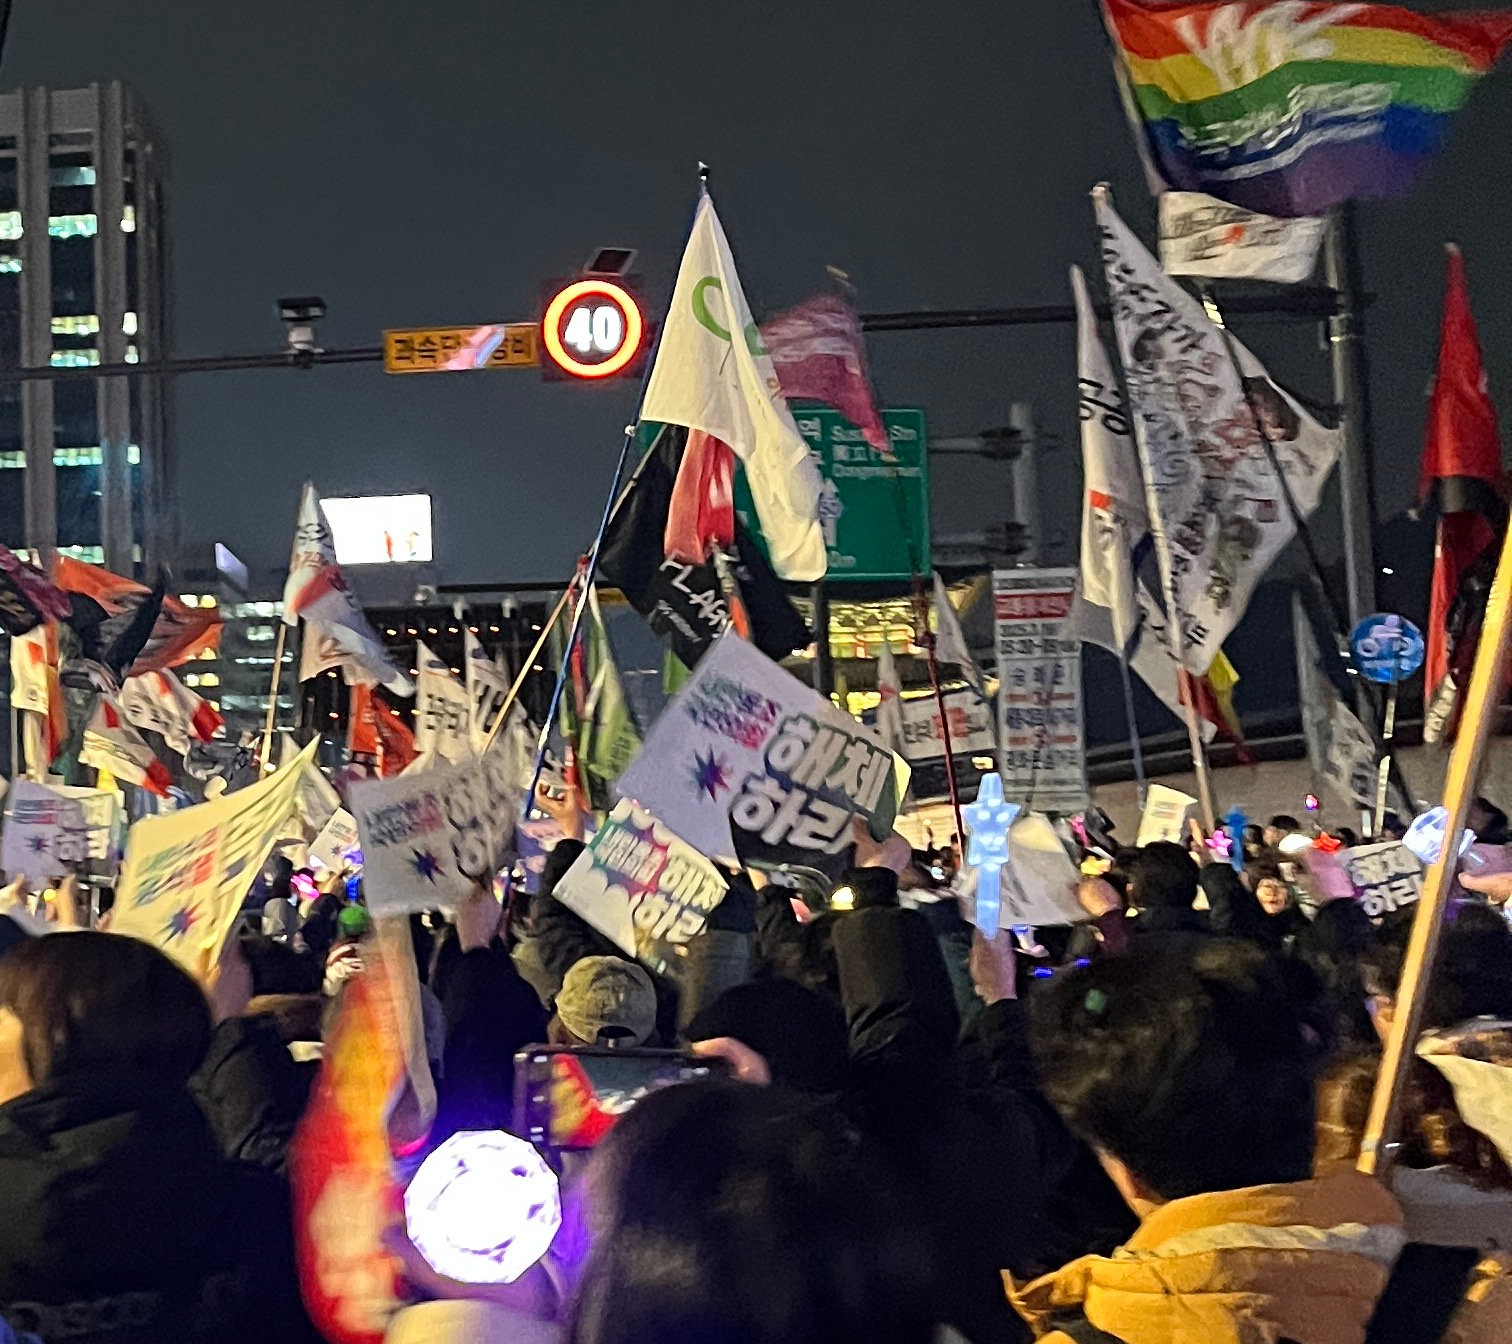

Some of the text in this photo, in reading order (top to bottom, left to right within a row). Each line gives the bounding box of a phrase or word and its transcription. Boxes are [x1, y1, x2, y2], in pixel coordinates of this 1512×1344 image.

[564, 305, 622, 353] 40
[764, 713, 893, 813] 해체
[730, 774, 856, 856] 하라
